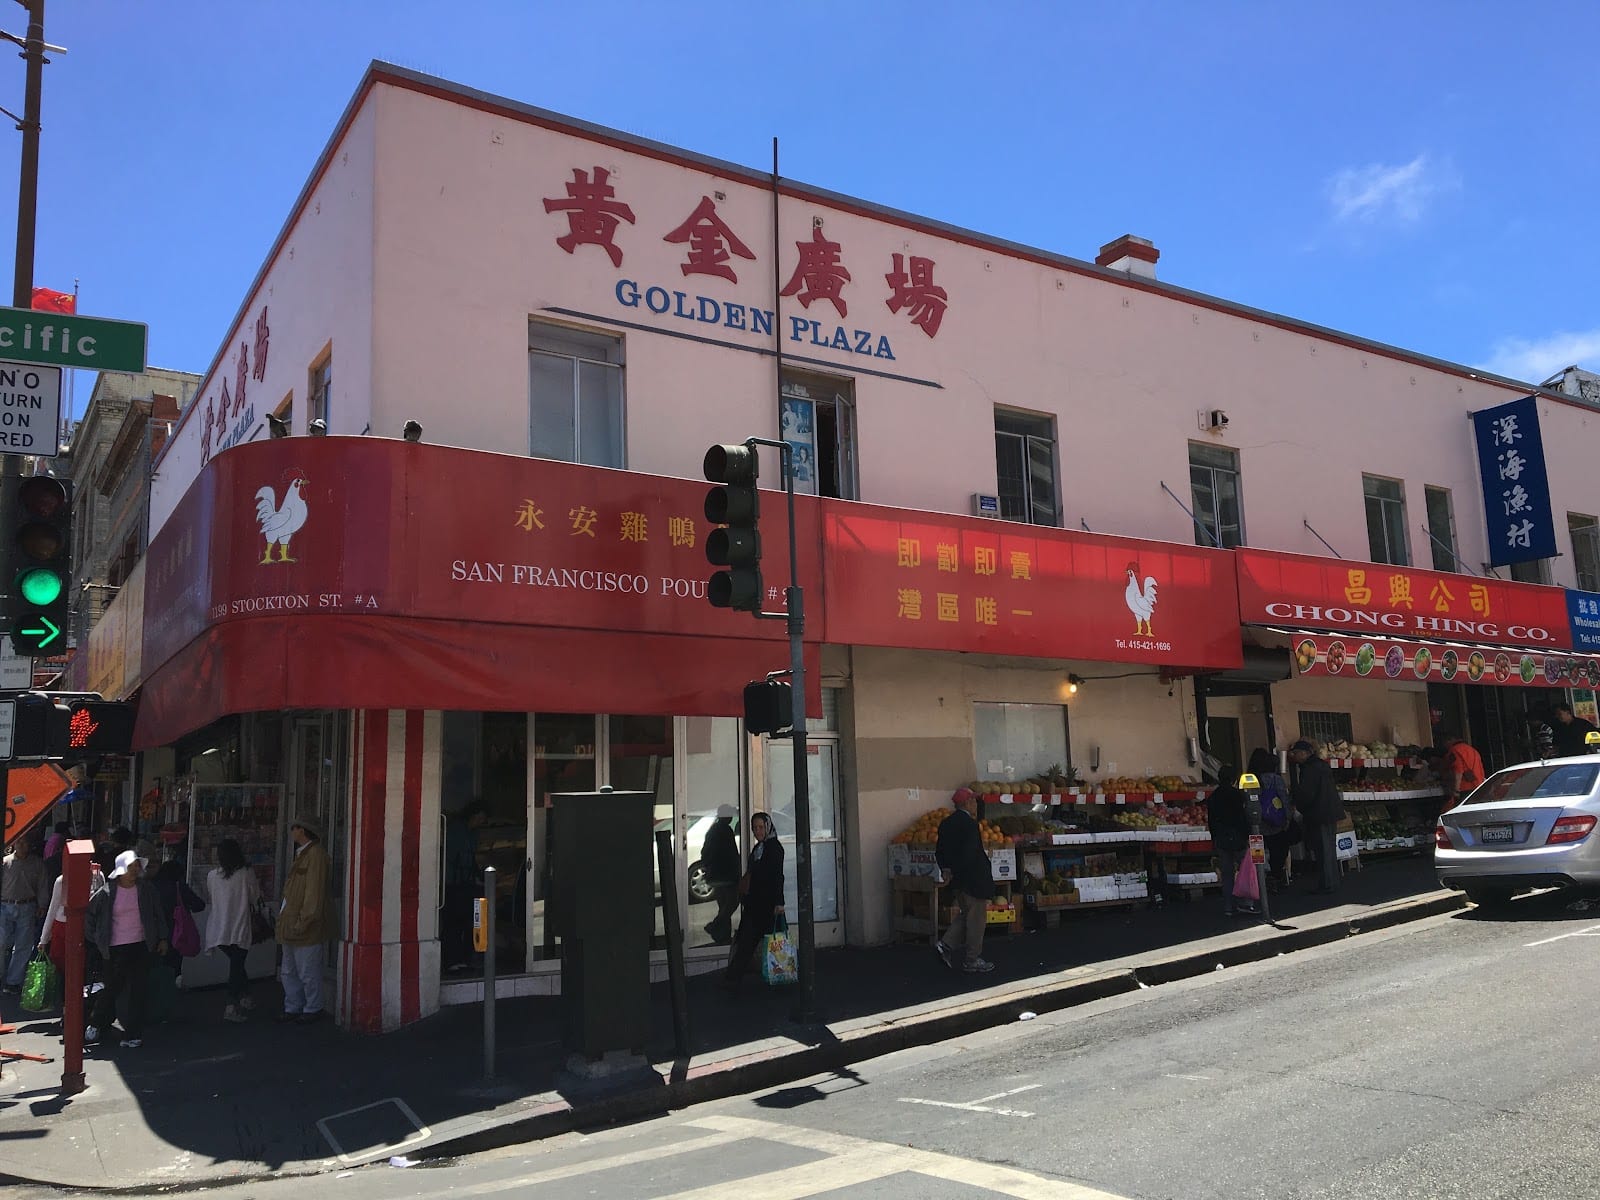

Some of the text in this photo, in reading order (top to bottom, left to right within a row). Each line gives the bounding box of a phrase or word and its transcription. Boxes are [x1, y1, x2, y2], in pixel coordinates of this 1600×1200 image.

[542, 166, 948, 339] 黃金廣場
[615, 279, 897, 360] GOLDEN PLAZA
[0, 369, 40, 389] NO
[0, 392, 42, 410] URN
[2, 412, 30, 428] ON
[451, 560, 505, 583] SAN
[511, 564, 649, 594] FRANCISCO
[1344, 568, 1491, 618] 昌興公司
[231, 594, 310, 613] STOCKTON
[319, 594, 343, 607] ST.
[897, 588, 1033, 626] 灣區唯一
[1265, 602, 1557, 641] CHONG HING CO.
[1115, 639, 1128, 649] Tel.
